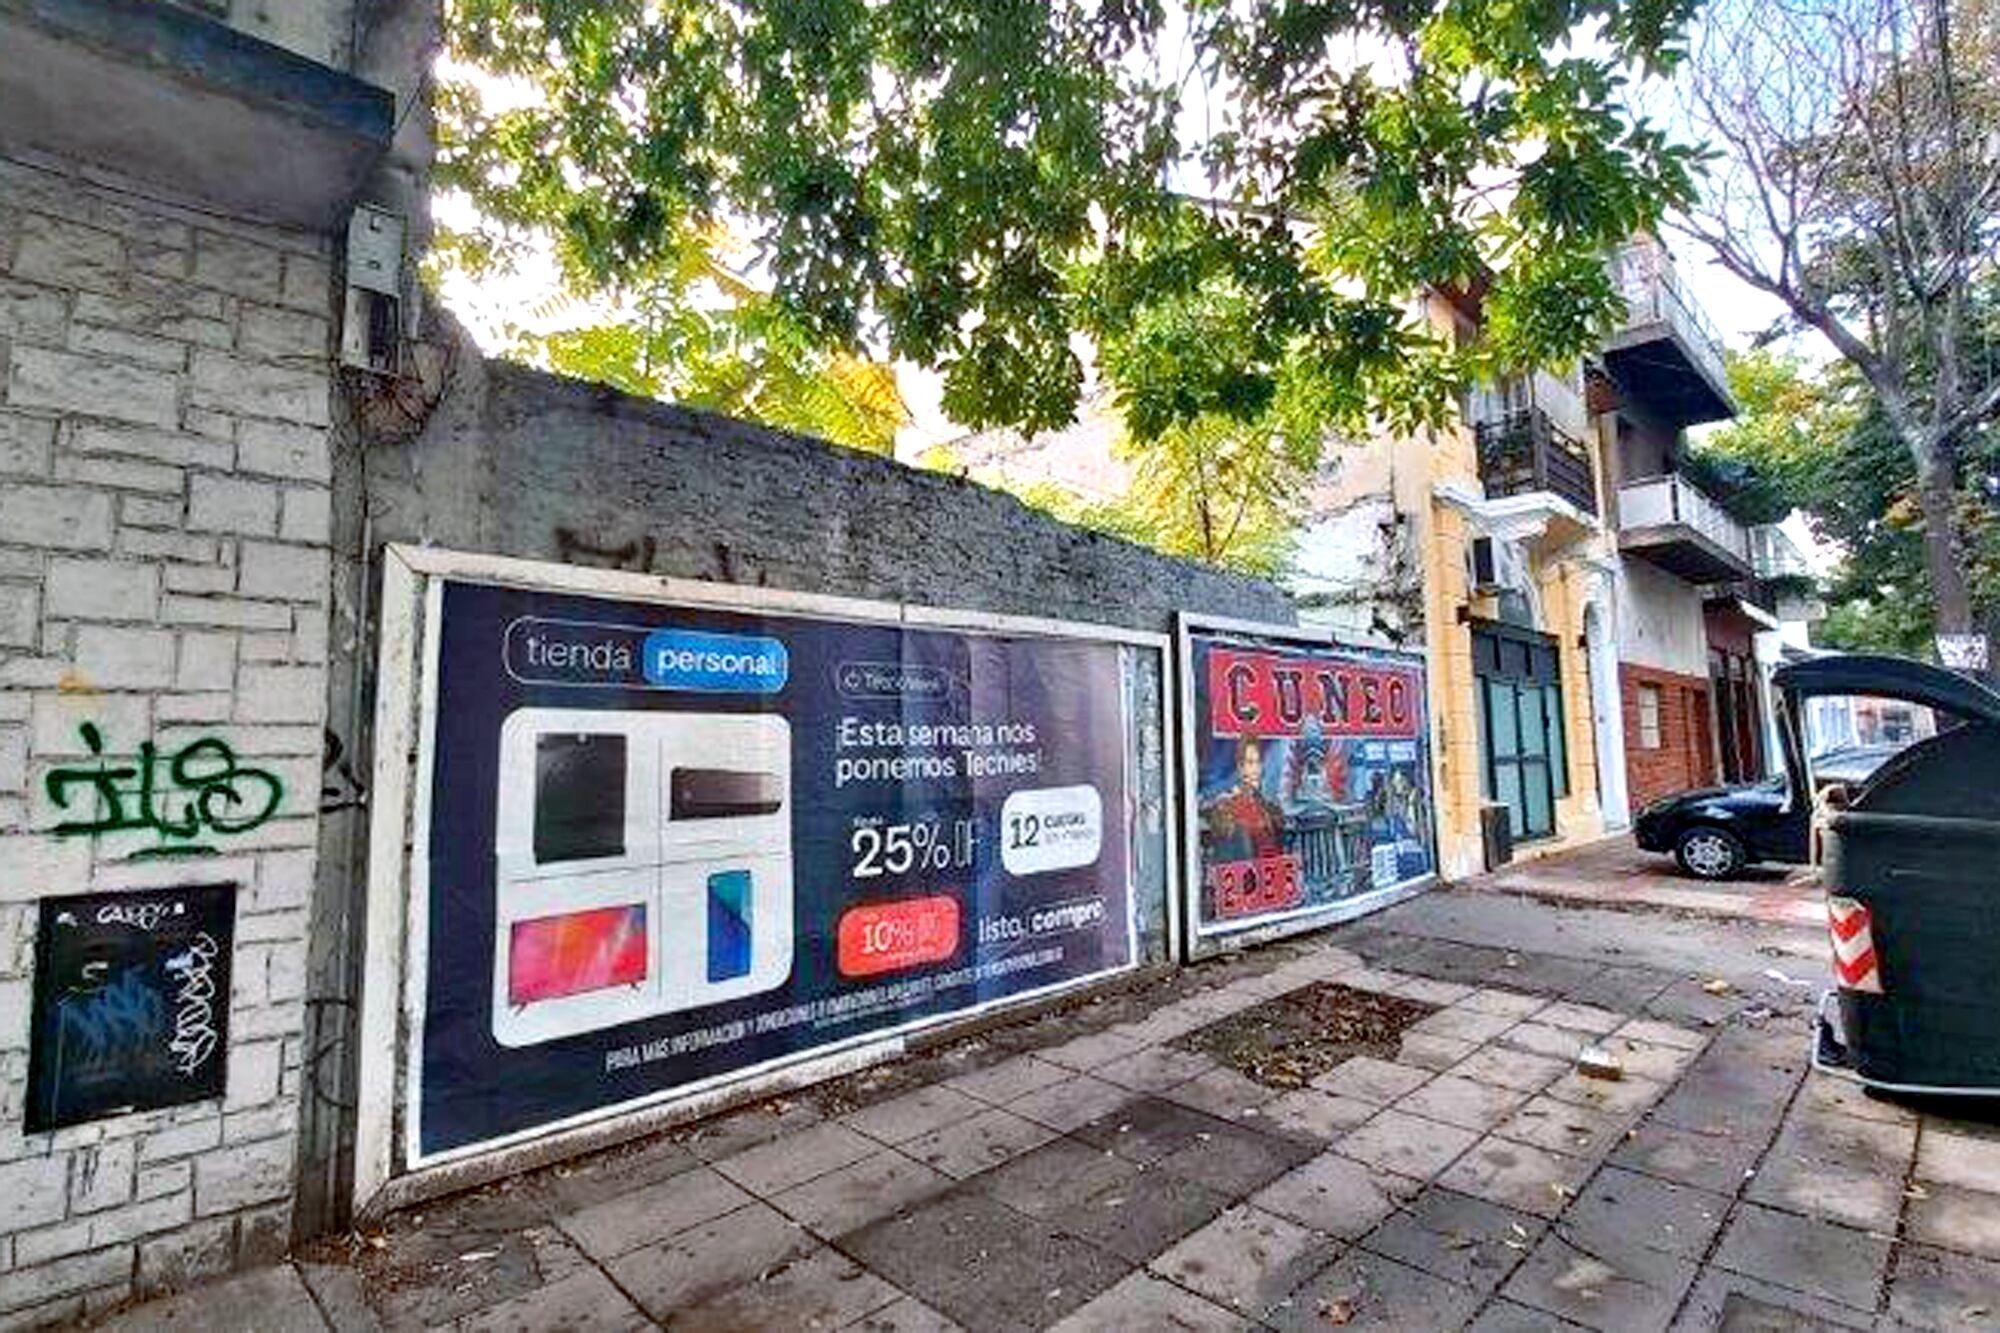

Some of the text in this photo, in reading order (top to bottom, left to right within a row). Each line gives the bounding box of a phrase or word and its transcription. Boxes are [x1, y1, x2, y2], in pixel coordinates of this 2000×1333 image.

[525, 635, 778, 677] tienda personal
[1225, 664, 1407, 724] CUNEO
[908, 724, 993, 746] semana
[997, 724, 1037, 744] nos
[835, 756, 957, 788] ponemos
[852, 824, 951, 877] 25%
[1010, 815, 1040, 849] 12
